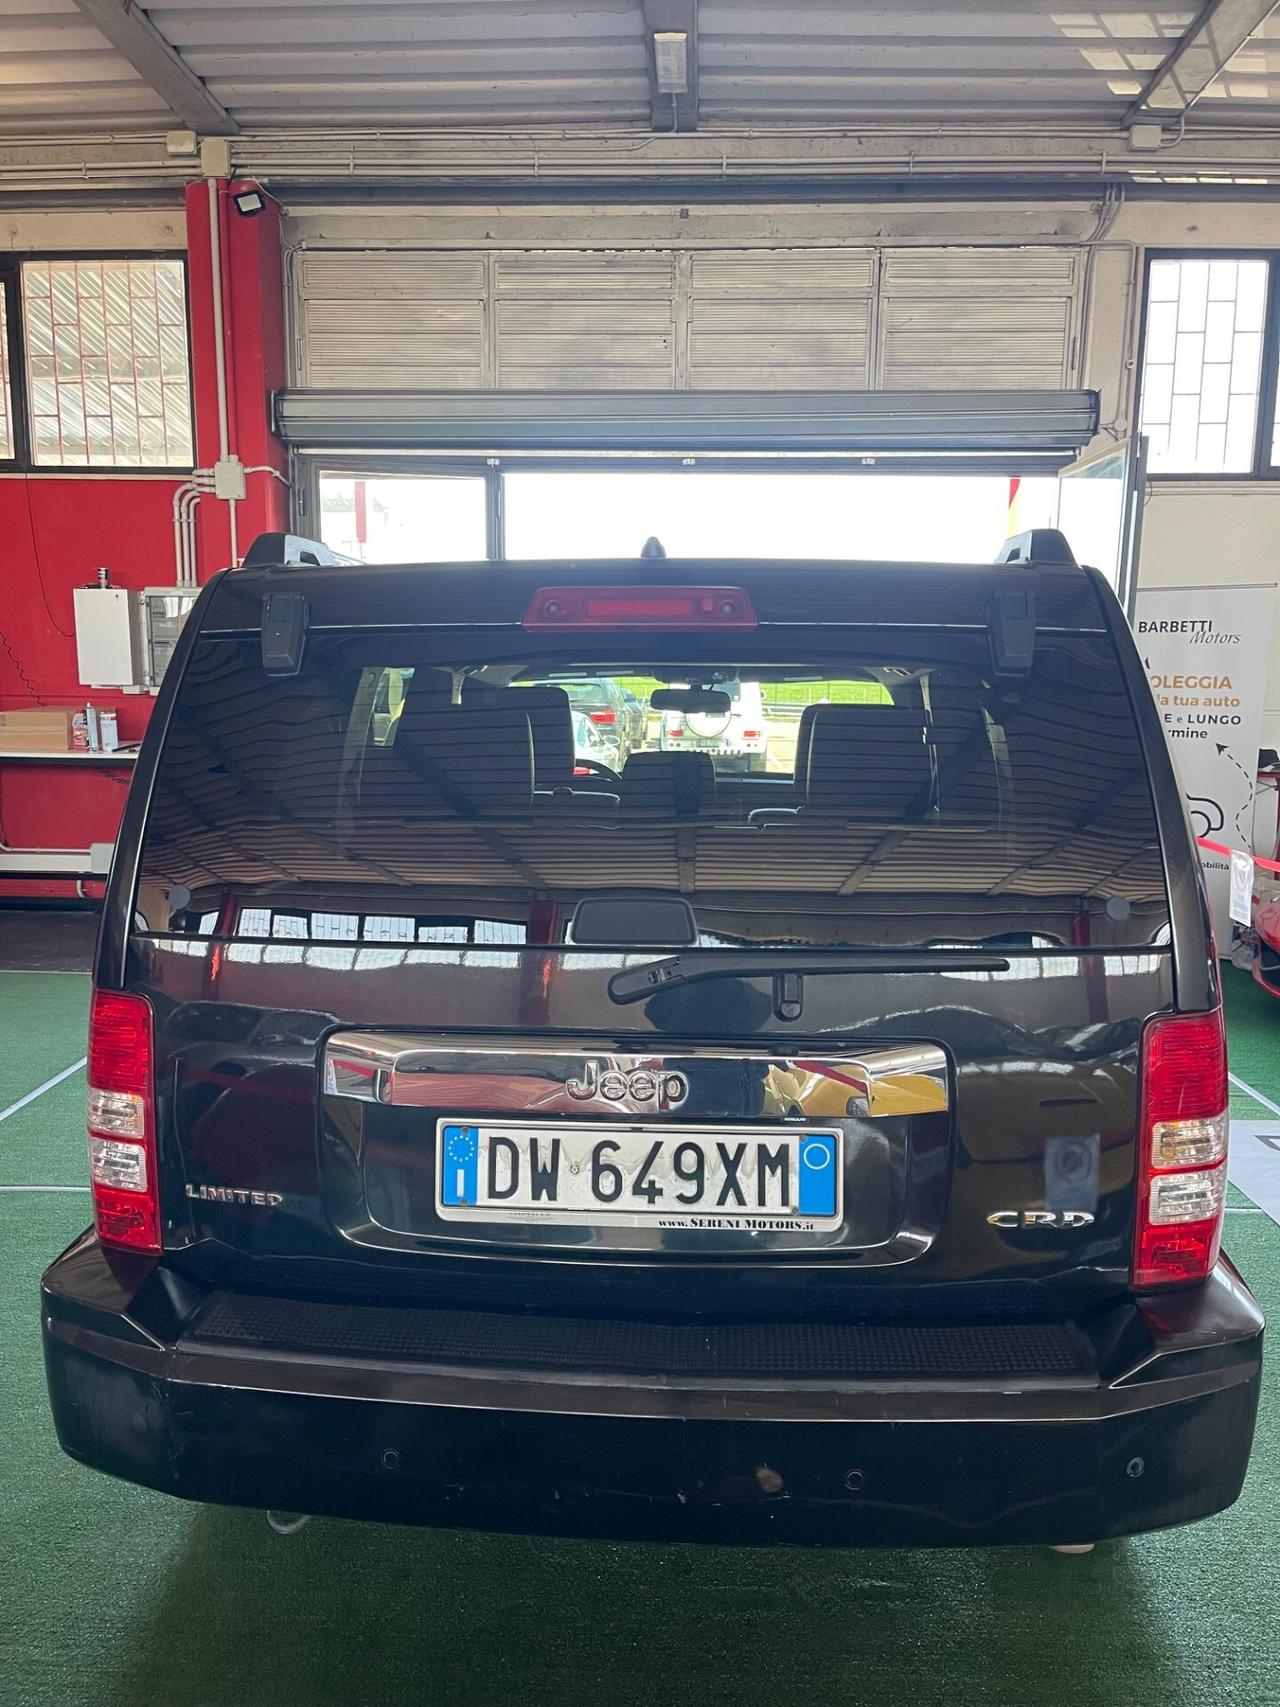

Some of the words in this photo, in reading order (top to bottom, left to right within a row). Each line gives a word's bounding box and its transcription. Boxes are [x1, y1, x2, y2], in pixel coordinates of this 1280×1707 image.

[1138, 620, 1213, 633] BARBETTI
[1189, 631, 1242, 644] Motors
[1173, 695, 1200, 706] tua
[1203, 696, 1240, 707] auto
[1187, 714, 1241, 725] LUNGO
[566, 1062, 689, 1112] Jeep
[185, 1183, 284, 1207] LIMITED
[690, 1217, 740, 1229] SERENI
[986, 1211, 1096, 1229] CRD
